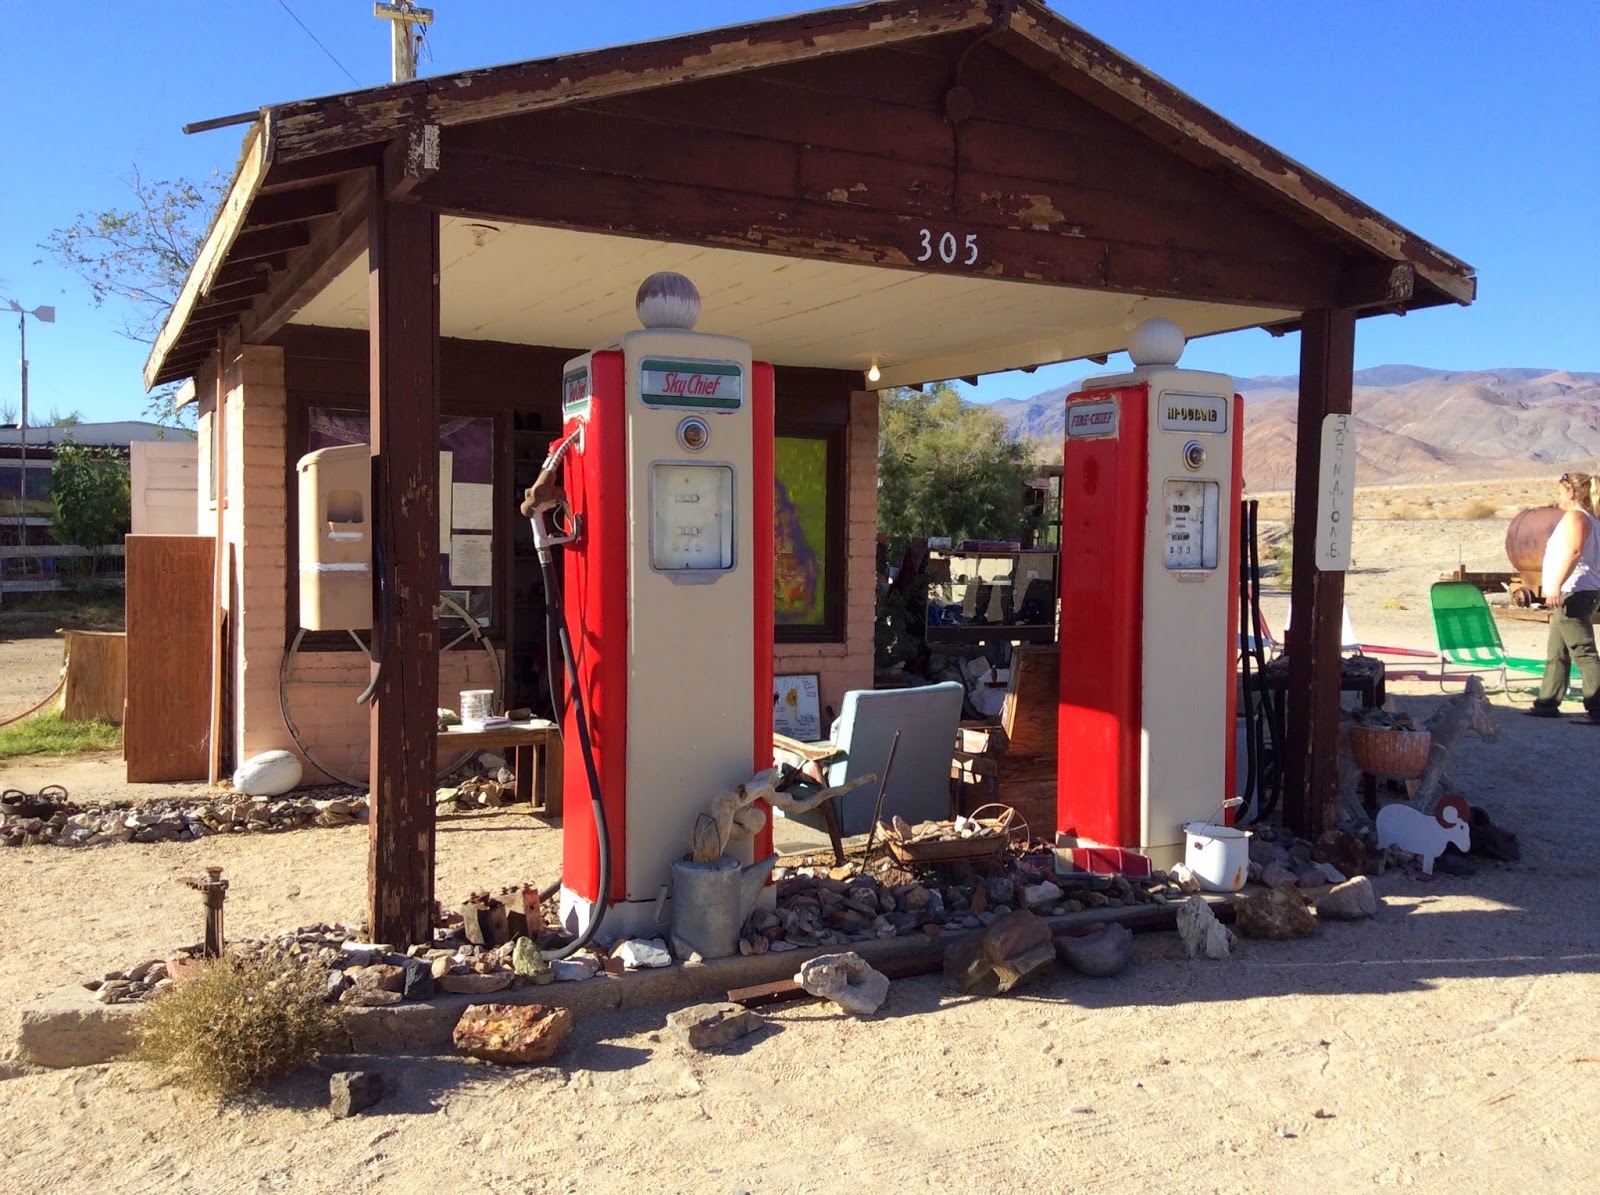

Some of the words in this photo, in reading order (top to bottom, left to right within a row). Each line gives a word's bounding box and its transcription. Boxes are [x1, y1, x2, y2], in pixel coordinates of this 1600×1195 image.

[917, 228, 979, 265] 305
[662, 372, 687, 397] Sky
[687, 373, 722, 396] Chief
[1071, 411, 1114, 427] FIRE-CHIEF
[1166, 406, 1218, 422] HI-OCTANE
